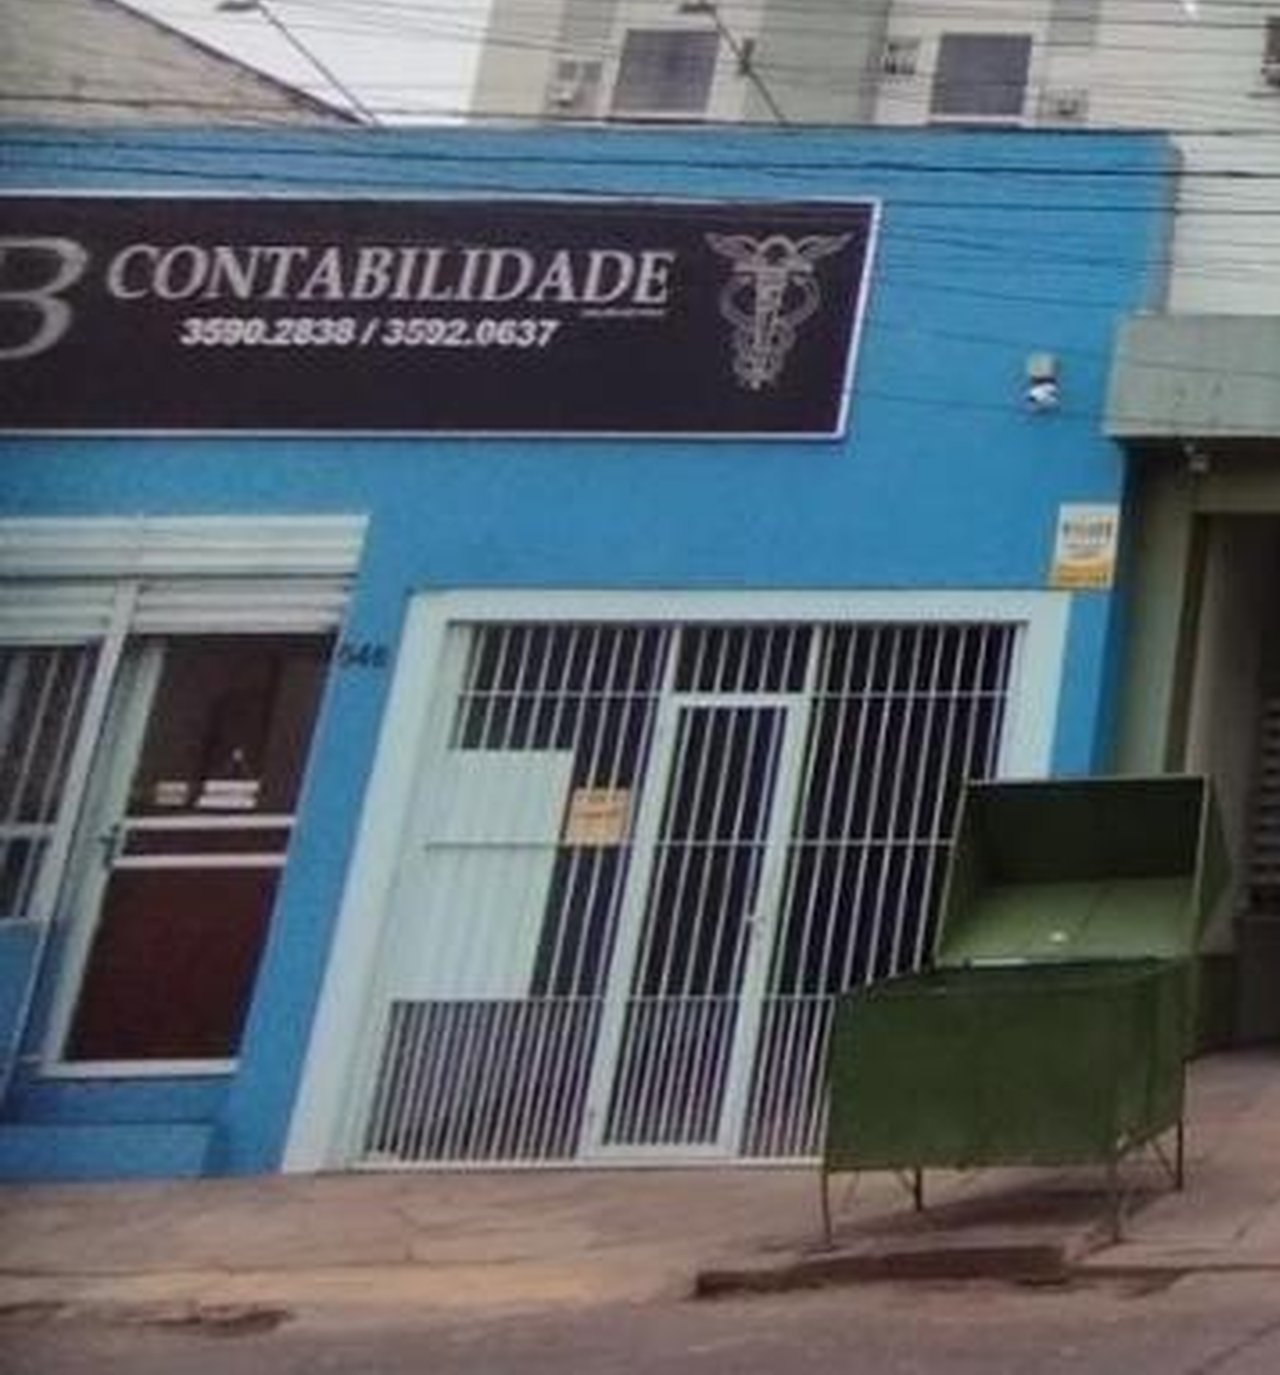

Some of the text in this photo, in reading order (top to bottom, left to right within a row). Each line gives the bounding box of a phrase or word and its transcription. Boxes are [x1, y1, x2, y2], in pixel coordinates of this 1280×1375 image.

[107, 243, 675, 306] CONTABILIDADE
[180, 317, 356, 346] 3590.2838
[382, 318, 559, 348] 3592.0637
